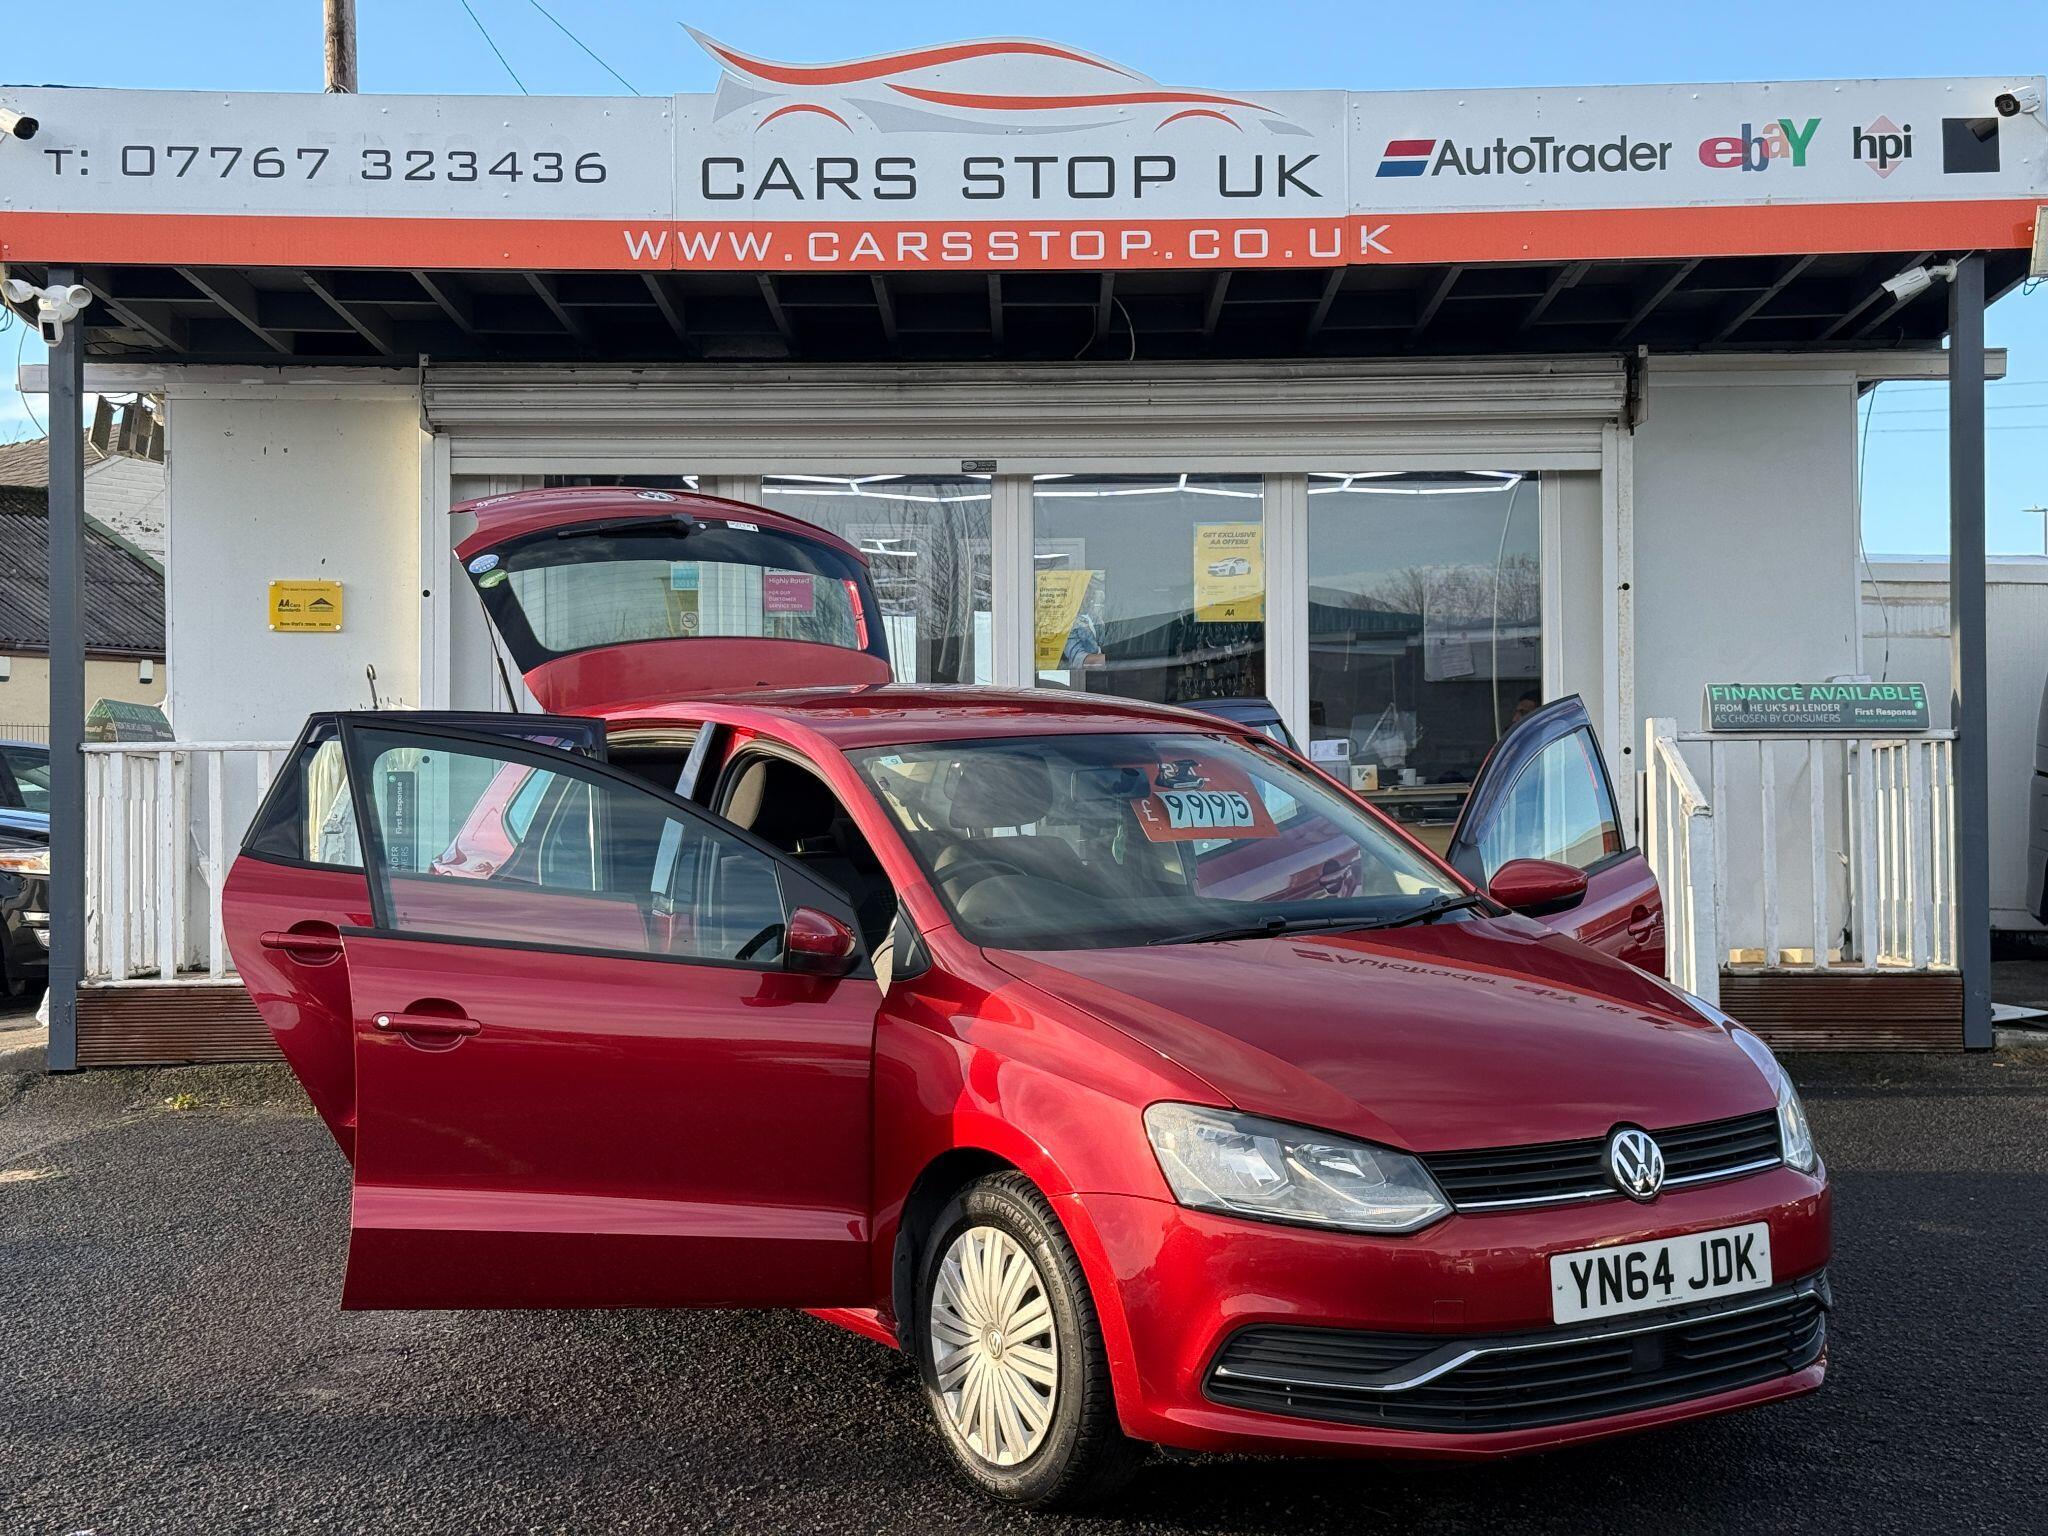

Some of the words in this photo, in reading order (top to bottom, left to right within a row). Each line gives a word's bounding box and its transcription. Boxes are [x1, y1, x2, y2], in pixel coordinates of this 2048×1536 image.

[1853, 123, 1912, 169] hpi
[1431, 135, 1673, 176] AutoTrader
[44, 149, 89, 176] T:
[121, 146, 330, 180] 07767
[361, 149, 608, 184] 323436
[702, 156, 918, 201] CARS
[962, 155, 1176, 200] STOP
[1219, 153, 1324, 198] UK
[623, 224, 1394, 263] WWW.CARSSTOP.CO.UK
[1203, 531, 1217, 539] GET
[1218, 531, 1257, 539] EXCLUSIVE
[768, 577, 789, 585] Highly
[278, 599, 290, 608] AA
[1224, 609, 1235, 617] AA
[1711, 686, 1805, 701] FINANCE
[1809, 686, 1923, 701] AVAILABLE
[1714, 703, 1742, 712] FROM
[1765, 703, 1788, 712] UK'S
[1802, 702, 1841, 712] LENDER
[1854, 707, 1874, 716] First
[1876, 707, 1918, 717] Response
[1714, 714, 1727, 723] AS
[1728, 714, 1767, 723] CHOSEN
[1769, 714, 1782, 723] BY
[1782, 713, 1841, 723] CONSUMERS
[395, 781, 404, 817] Response
[395, 818, 403, 835] First
[983, 1195, 1043, 1245] MICHELIN
[1569, 1247, 1675, 1309] YN64
[1688, 1233, 1758, 1290] JDK
